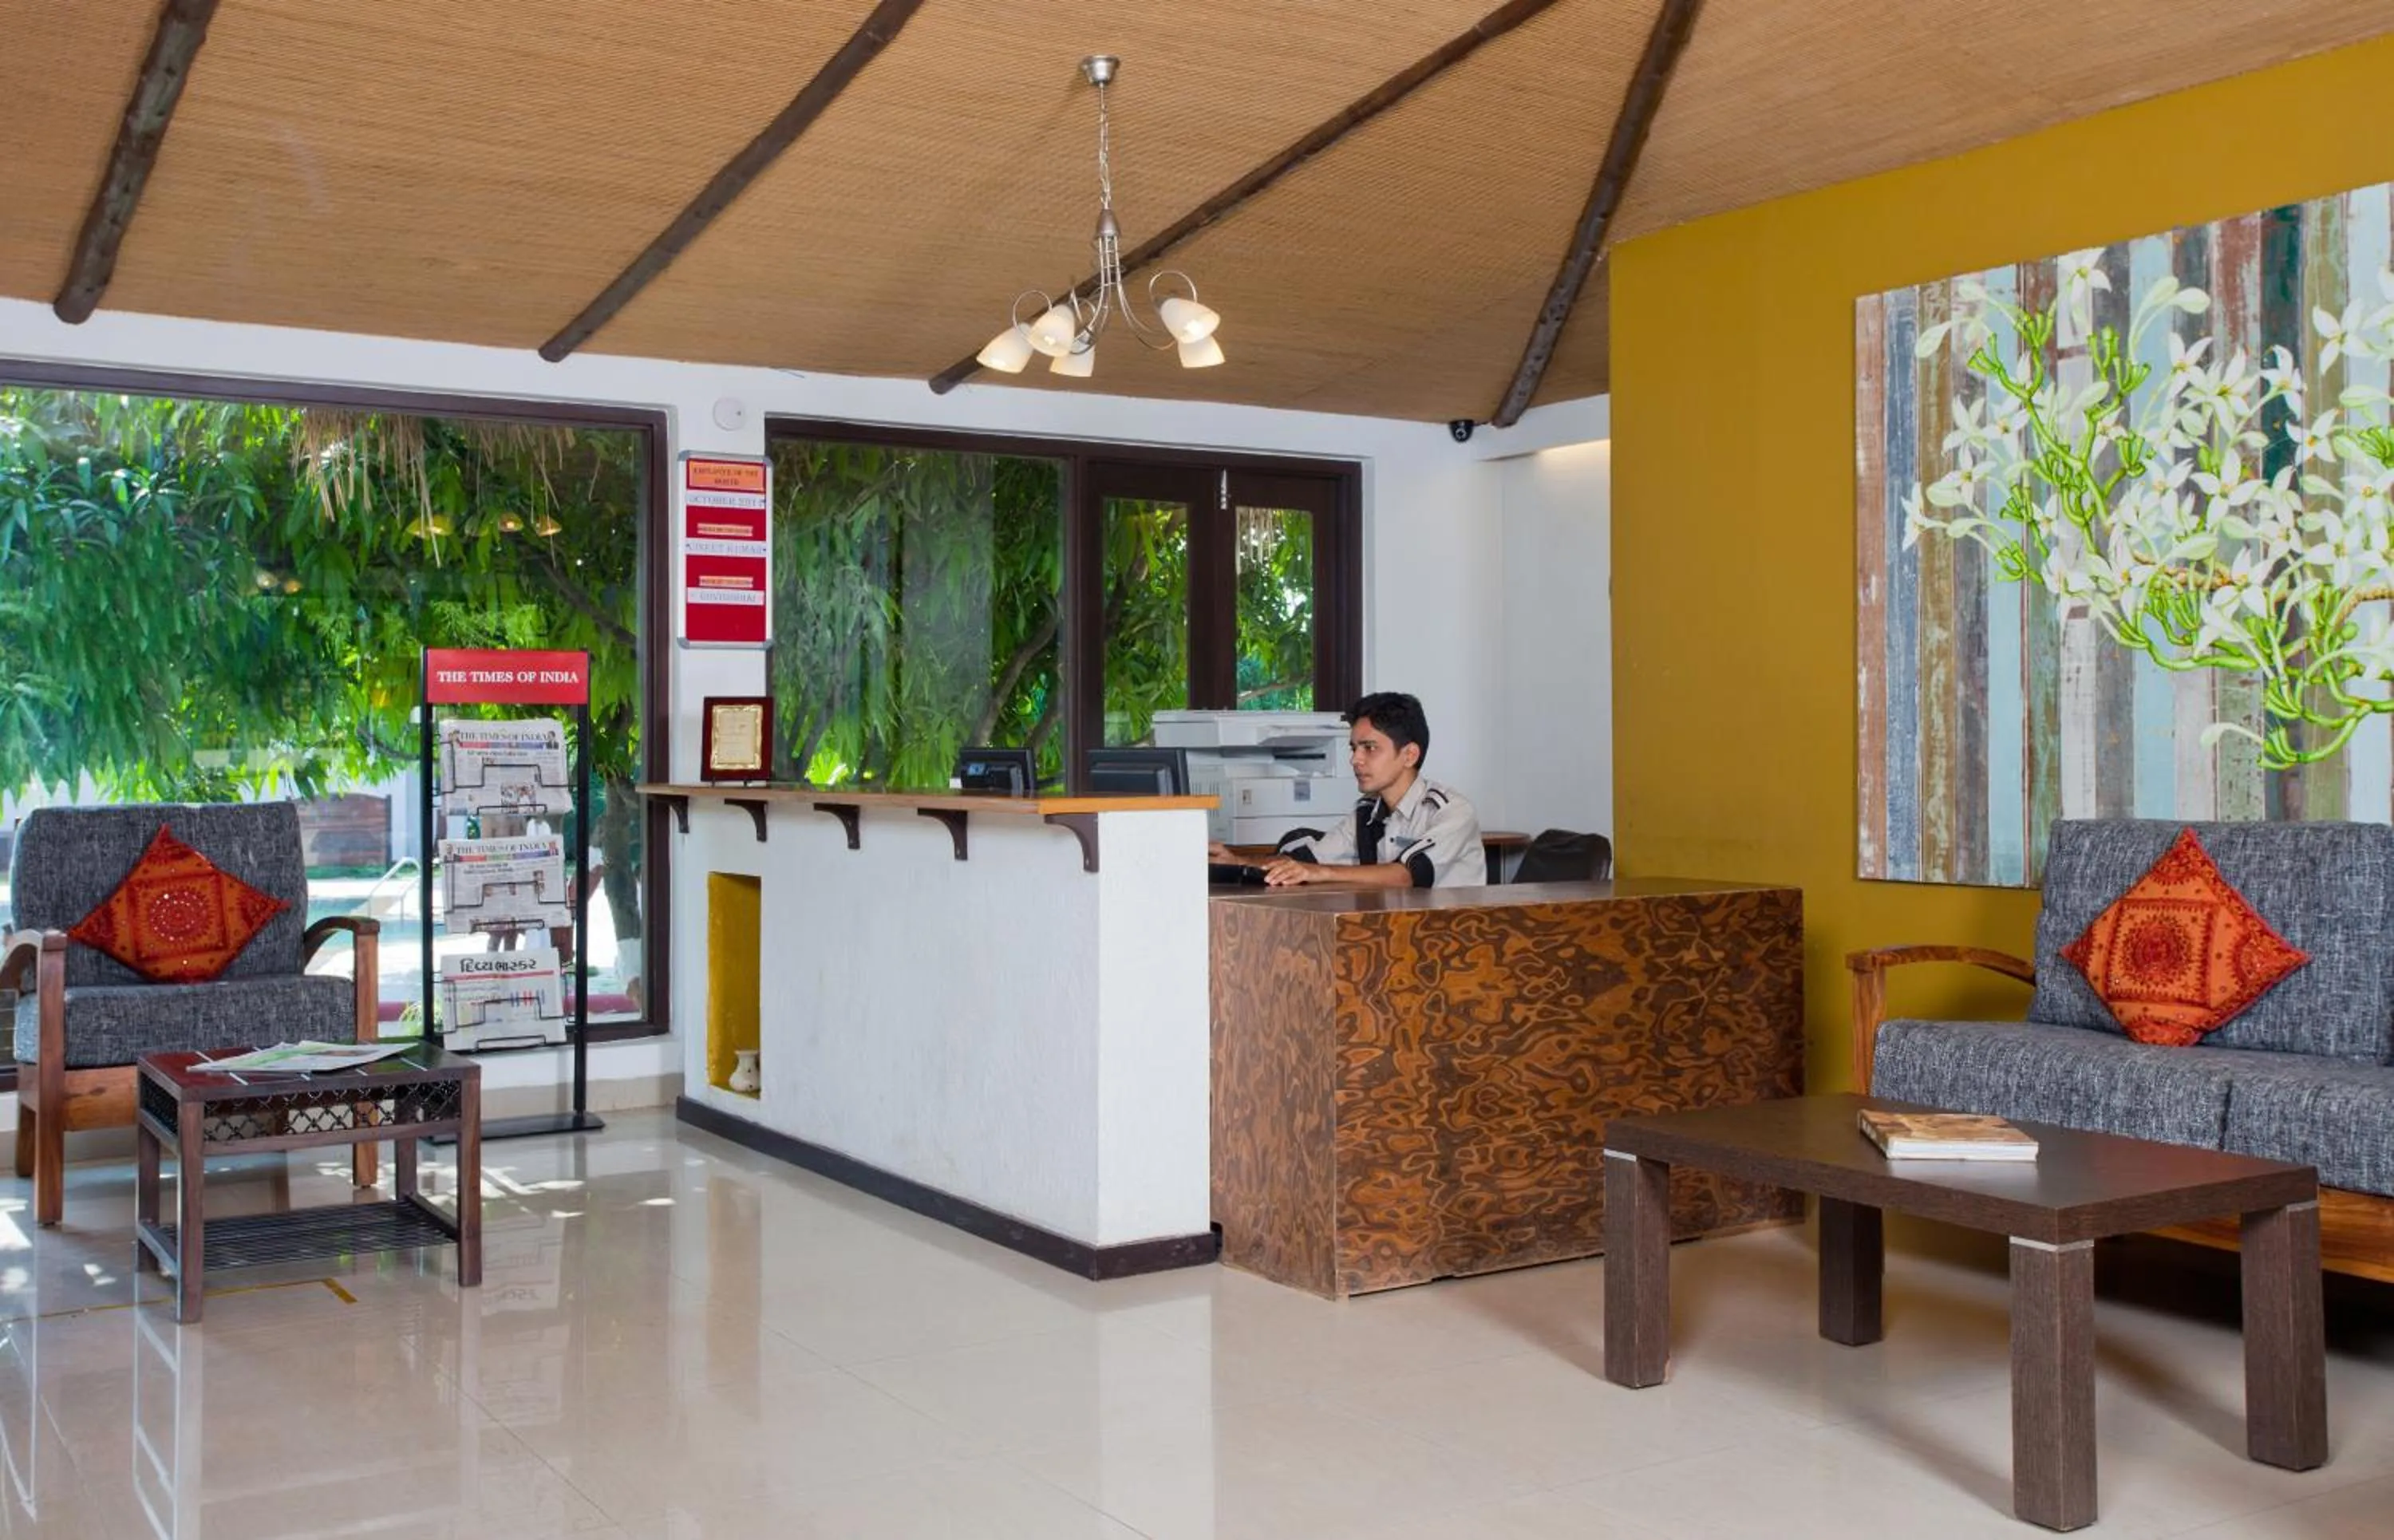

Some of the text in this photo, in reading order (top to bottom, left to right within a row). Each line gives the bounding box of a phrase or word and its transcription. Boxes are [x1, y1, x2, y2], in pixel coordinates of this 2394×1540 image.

[437, 671, 579, 684] THE TIMES OF INDIA
[460, 731, 548, 740] THE TIMES OF INDIA
[476, 844, 503, 854] TIMES
[519, 842, 547, 851] INDIA
